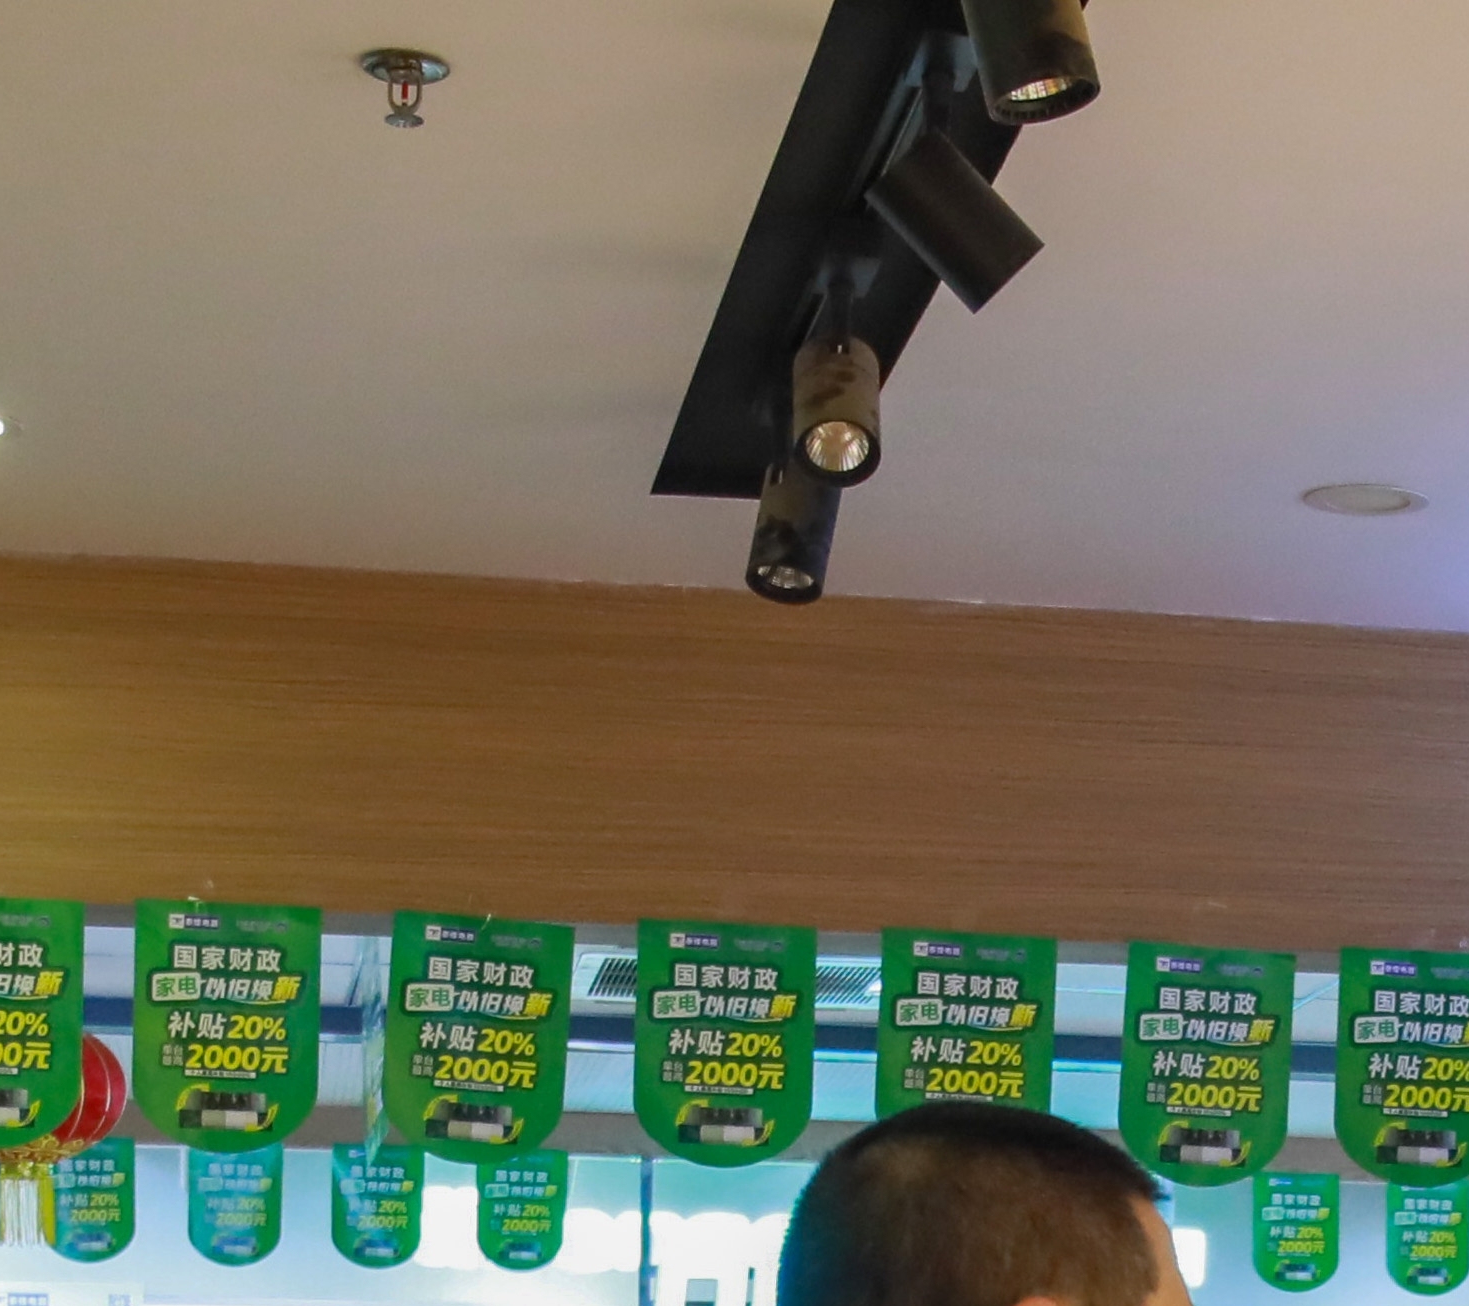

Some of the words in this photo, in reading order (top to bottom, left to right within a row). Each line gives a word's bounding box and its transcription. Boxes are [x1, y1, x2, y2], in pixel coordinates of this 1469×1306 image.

[174, 945, 282, 972] 国家财政
[428, 956, 535, 989] 国家财政
[675, 963, 778, 991] 国家财政
[917, 972, 1019, 1000] 国家财政
[1159, 987, 1257, 1015] 国家财政
[168, 1011, 286, 1040] 补贴20%
[419, 1021, 536, 1056] 补贴20%
[669, 1028, 783, 1057] 补贴20%
[910, 1036, 1022, 1066] 补贴20%
[186, 1044, 288, 1073] 2000元
[435, 1055, 537, 1089] 2000元
[1152, 1050, 1260, 1080] 补贴20%
[686, 1061, 784, 1090] 2000元
[927, 1068, 1024, 1098] 2000元
[1167, 1082, 1261, 1112] 2000元
